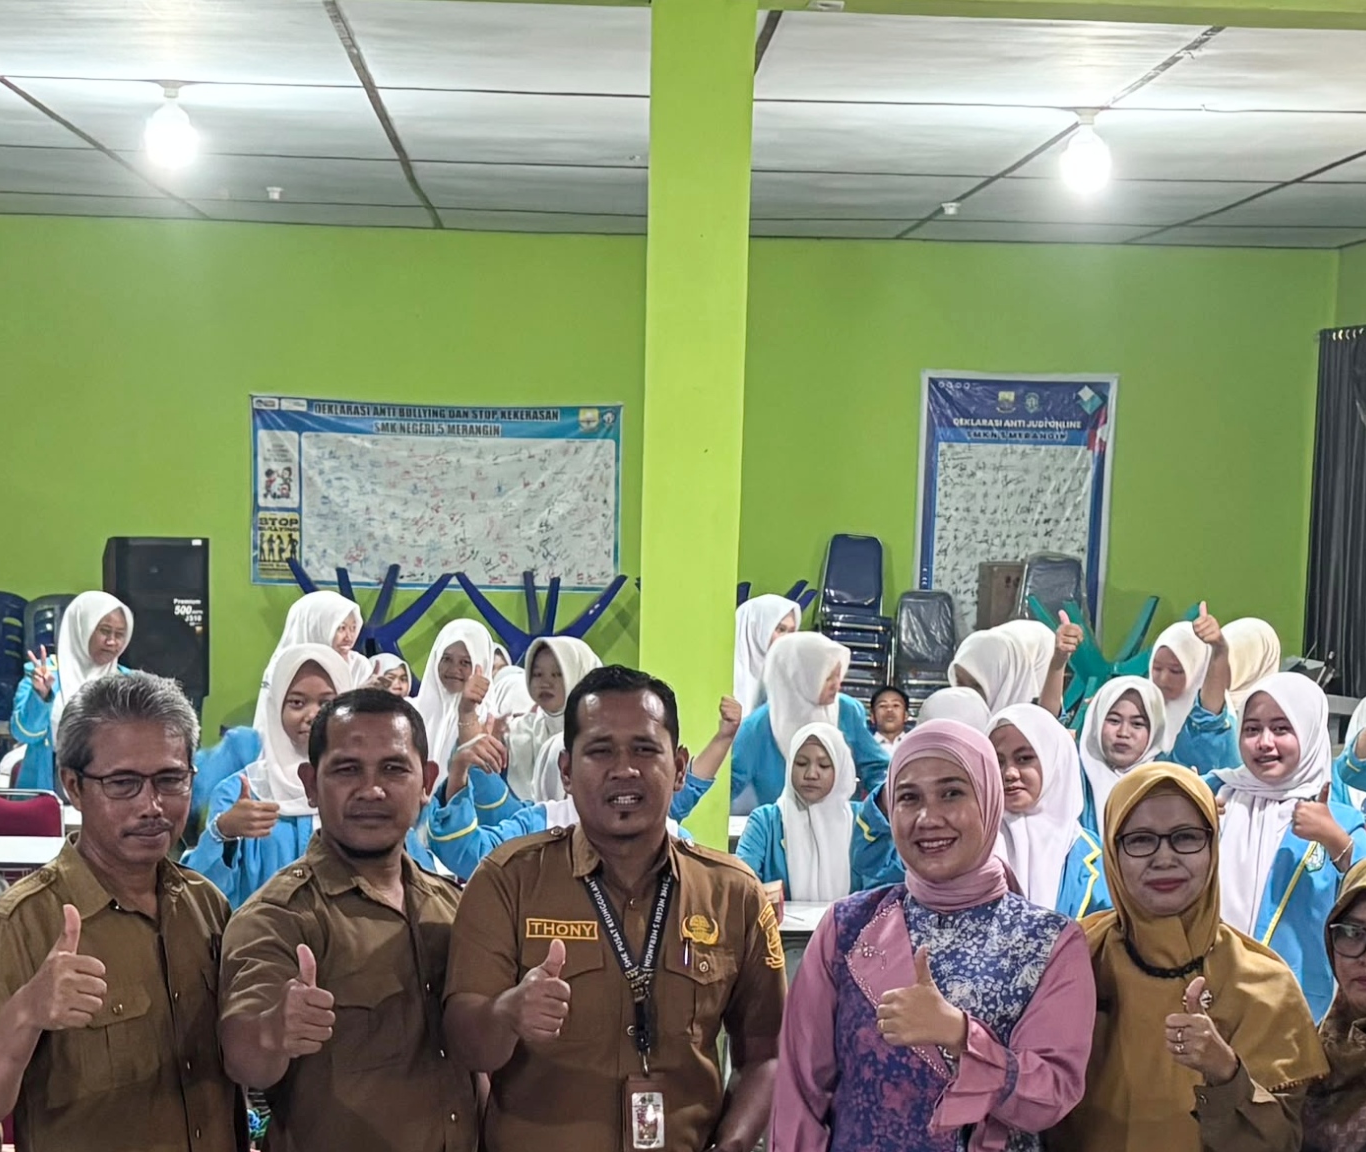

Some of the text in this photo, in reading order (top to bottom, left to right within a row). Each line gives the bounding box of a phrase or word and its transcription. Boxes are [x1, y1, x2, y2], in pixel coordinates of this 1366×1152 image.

[373, 405, 396, 416] ANTI
[399, 407, 445, 419] BULLYING
[449, 408, 469, 419] DAN
[471, 409, 498, 420] STOP
[501, 410, 559, 422] KEKERASAN
[374, 421, 500, 436] SMK NEGERI 5 MERANGIN
[953, 417, 1002, 428] DEKLARASI
[1004, 419, 1025, 428] ANTI
[1027, 420, 1046, 429] JUDI
[259, 517, 299, 527] STOP
[174, 605, 192, 615] 500
[659, 882, 669, 898] SMK
[653, 898, 666, 924] NEGERI
[530, 922, 593, 937] THONY
[589, 881, 633, 968] SMK PUSAT KEUNGGULAN
[643, 929, 659, 968] MERANGIN
